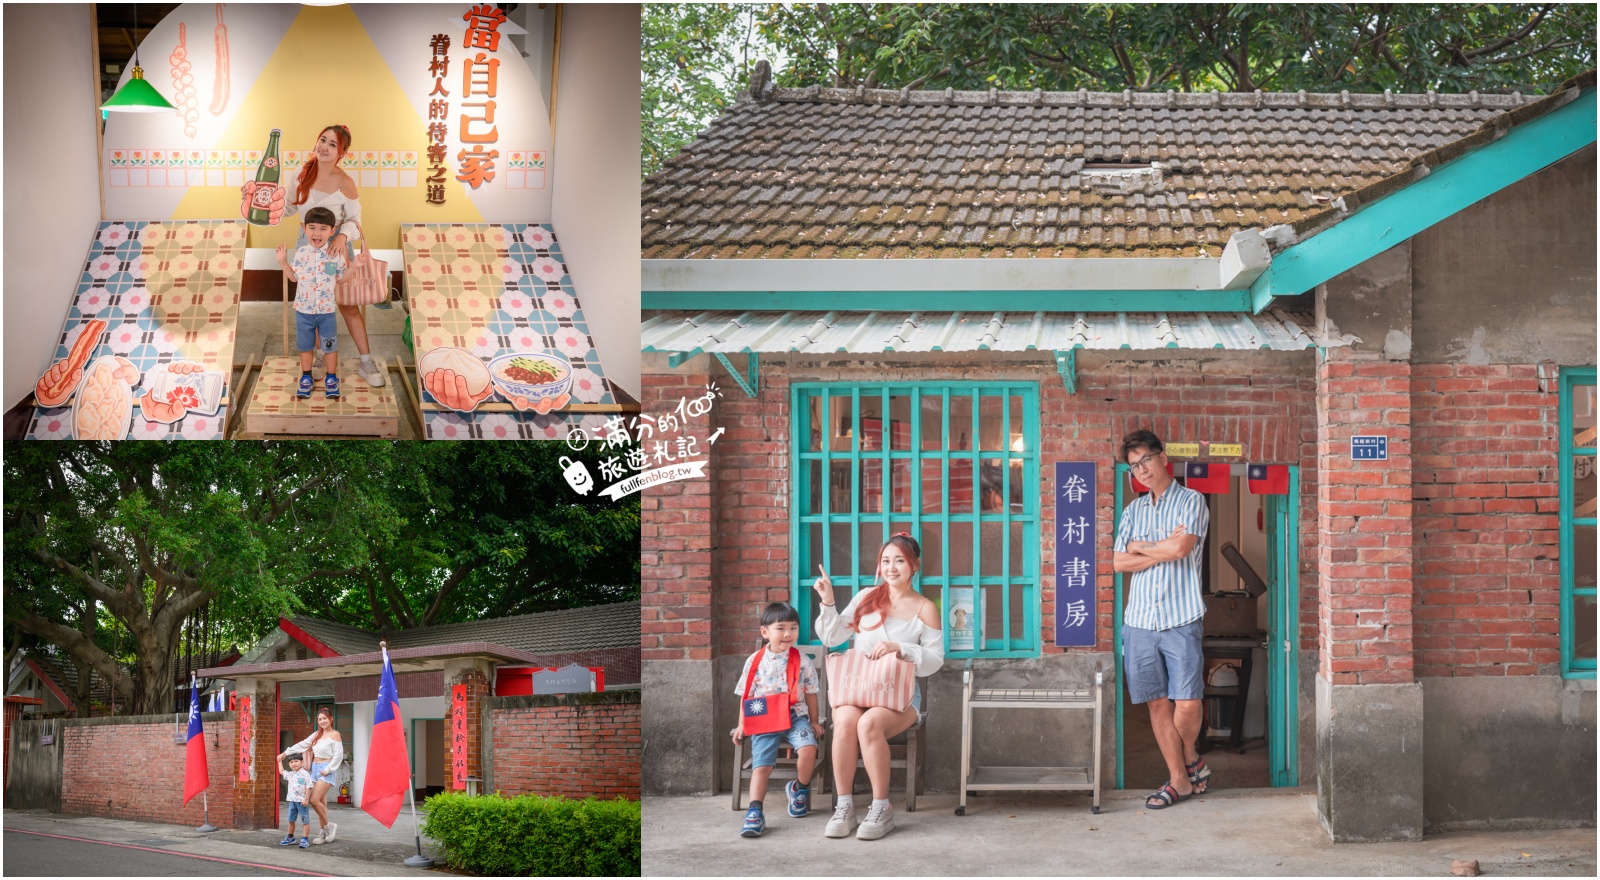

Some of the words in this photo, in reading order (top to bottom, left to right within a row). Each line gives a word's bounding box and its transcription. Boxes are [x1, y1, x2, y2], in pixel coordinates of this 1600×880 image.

[426, 33, 451, 205] 眷村人的待客之道
[456, 4, 507, 189] 當自己家
[1359, 448, 1372, 457] 11
[1061, 474, 1090, 629] 眷村書房
[844, 672, 895, 694] Chloé
